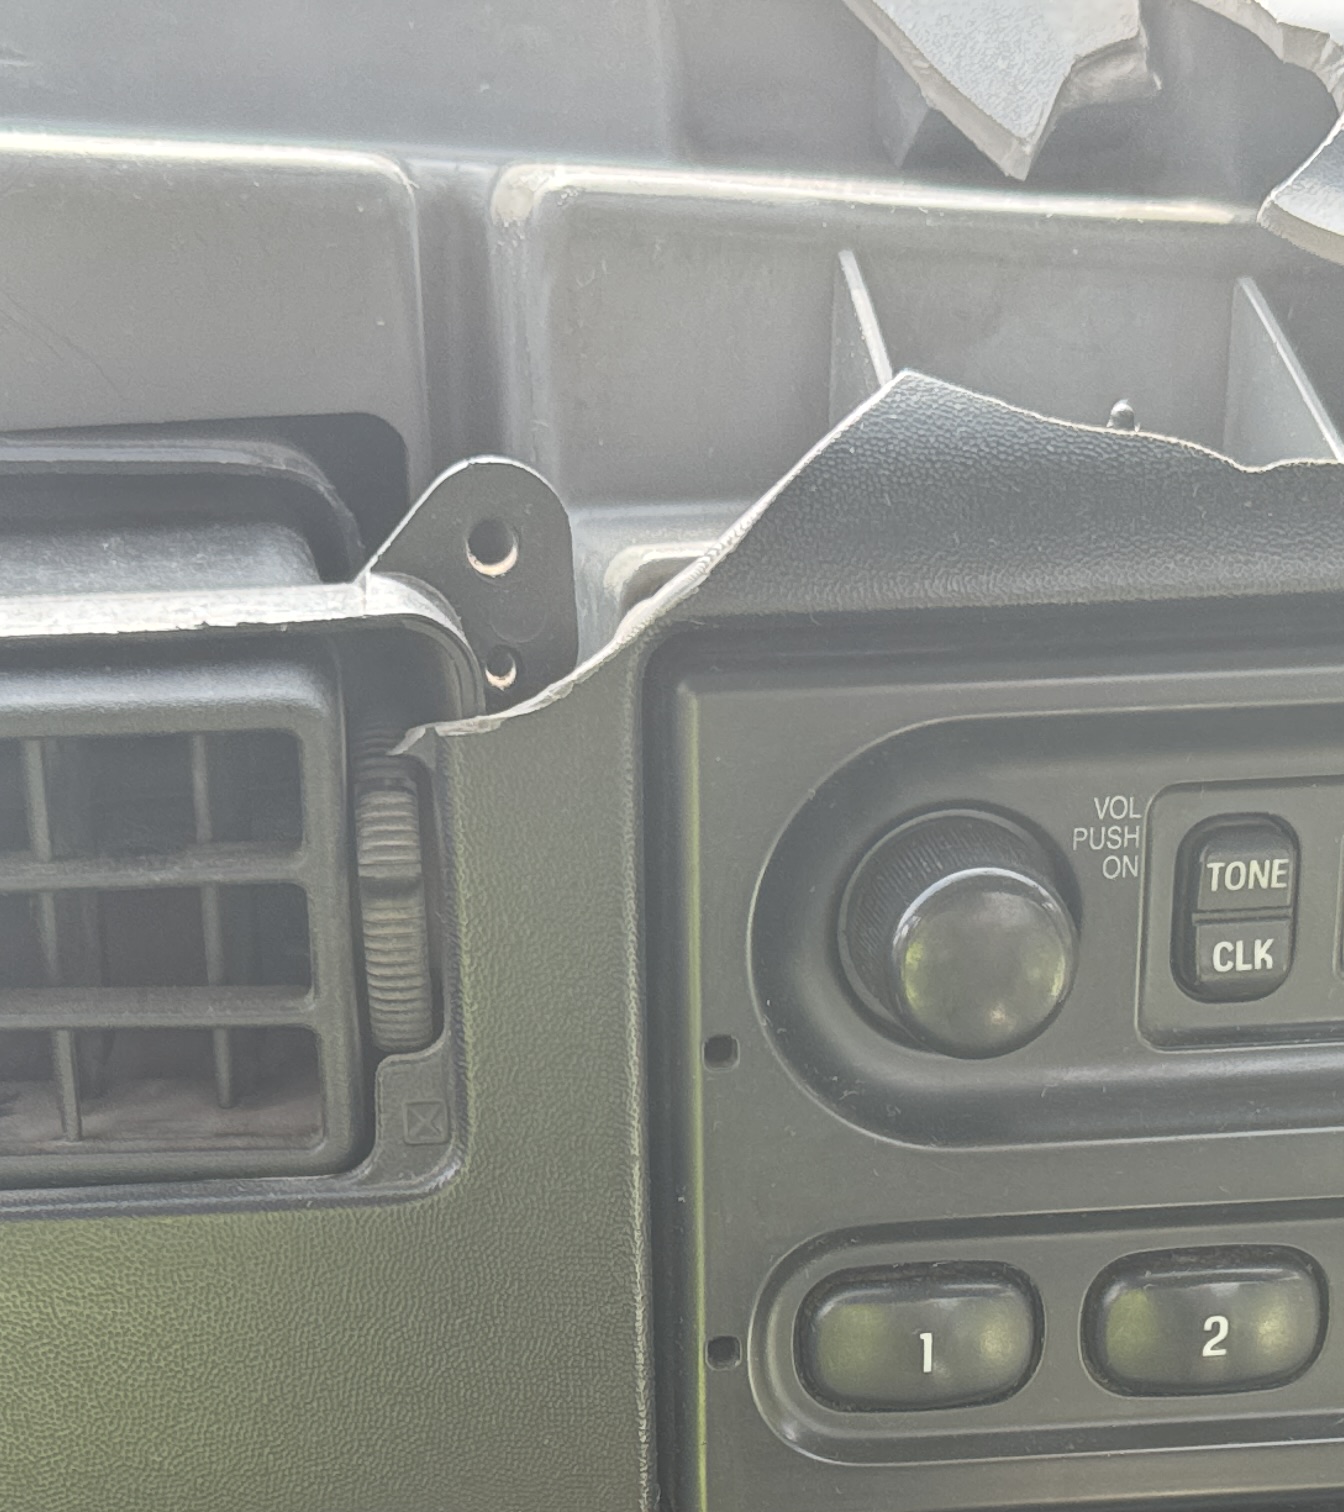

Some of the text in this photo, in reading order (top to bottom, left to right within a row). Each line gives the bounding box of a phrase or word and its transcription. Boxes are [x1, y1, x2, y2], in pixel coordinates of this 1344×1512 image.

[1093, 796, 1142, 821] VOL
[1072, 826, 1142, 851] PUSH
[1102, 855, 1140, 880] ON
[1206, 858, 1290, 893] TONE
[1211, 939, 1275, 975] CLK
[918, 1332, 935, 1374] 1
[1201, 1315, 1230, 1358] 2
